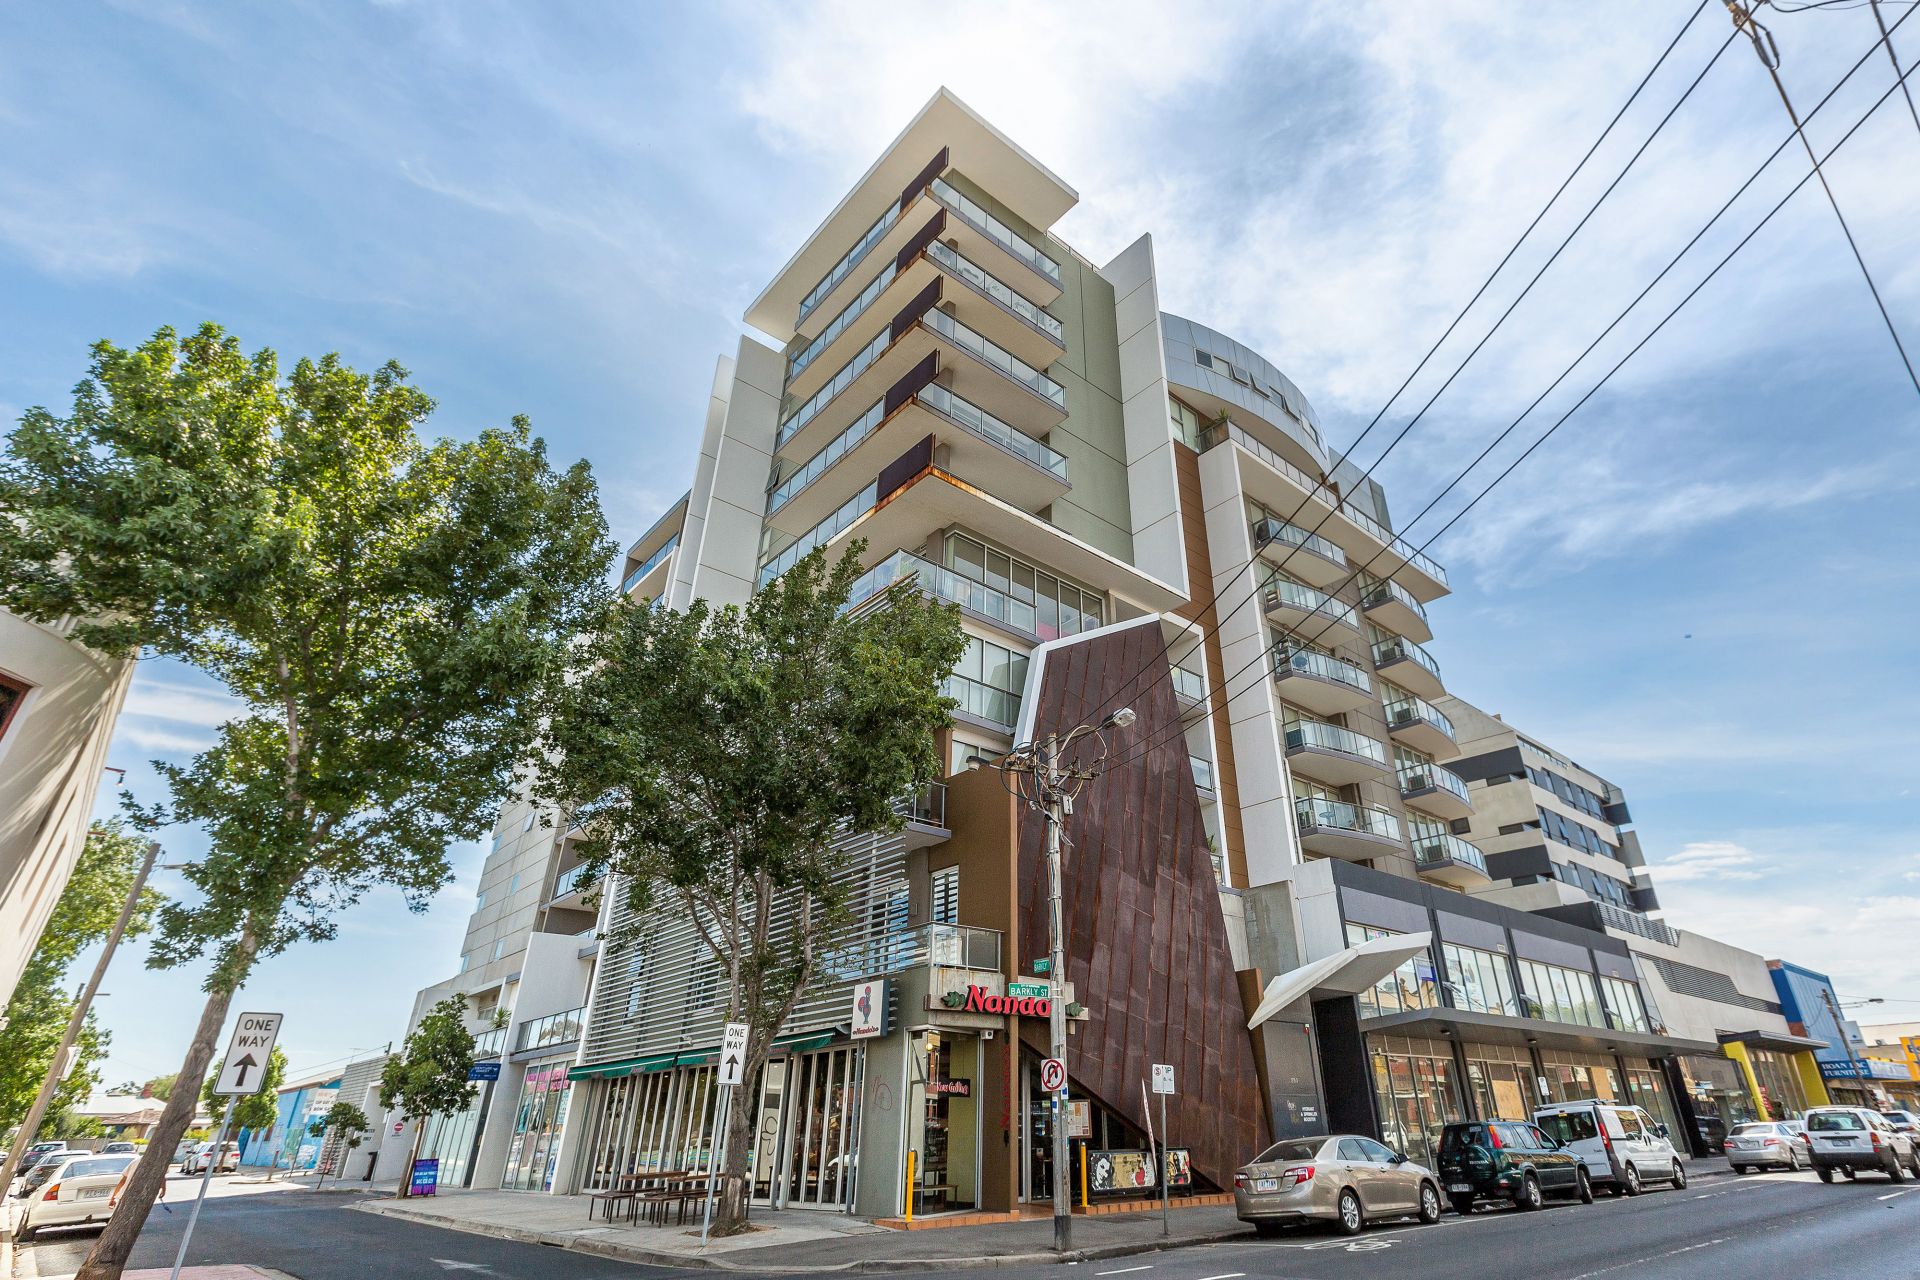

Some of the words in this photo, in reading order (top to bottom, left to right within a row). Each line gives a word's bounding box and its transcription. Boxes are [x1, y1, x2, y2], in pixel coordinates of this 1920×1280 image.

[1011, 987, 1038, 996] BARKLY
[1040, 989, 1048, 997] ST
[244, 1019, 274, 1031] ONE
[729, 1028, 745, 1038] ONE
[238, 1036, 270, 1047] WAY
[727, 1041, 744, 1050] WAY
[1822, 1062, 1847, 1070] HOAN
